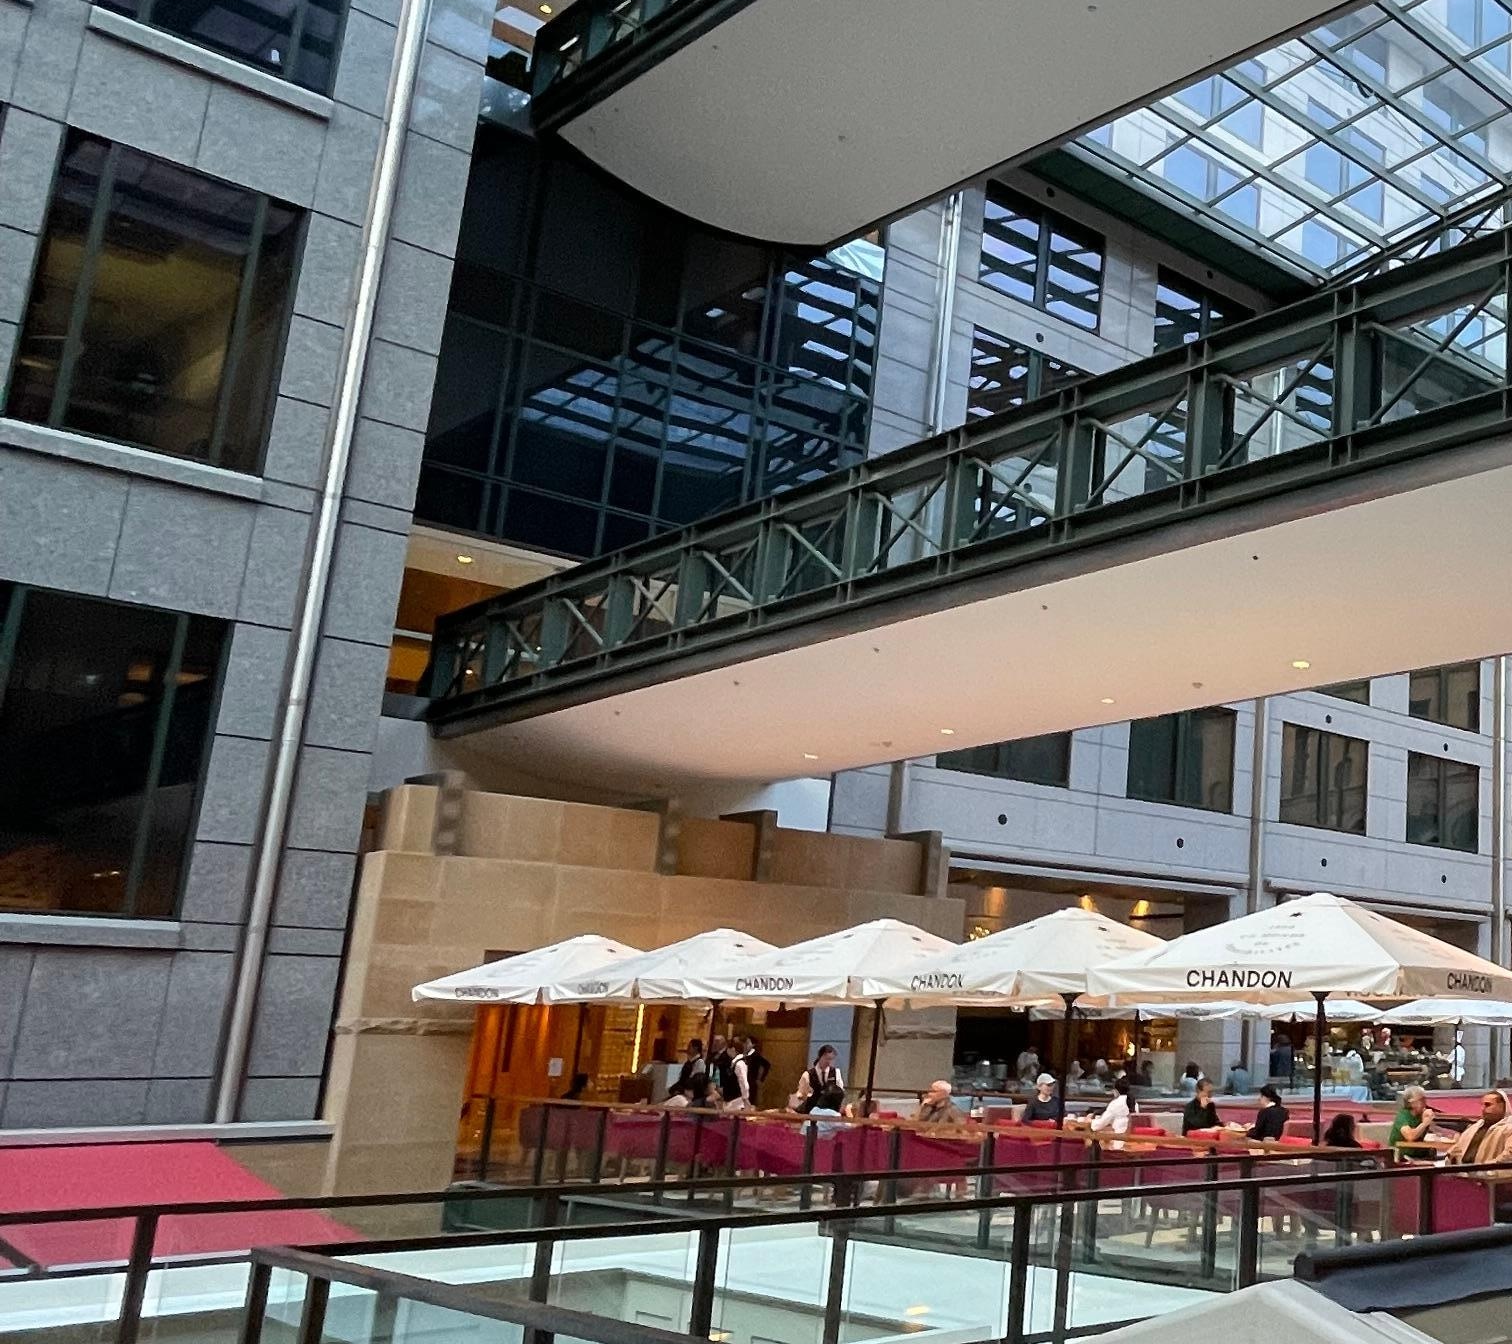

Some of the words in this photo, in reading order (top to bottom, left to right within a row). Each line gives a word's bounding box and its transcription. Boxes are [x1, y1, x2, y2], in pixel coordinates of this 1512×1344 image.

[735, 977, 794, 991] CHANDON
[911, 973, 963, 990] CHANDON
[1186, 969, 1293, 989] CHANDON
